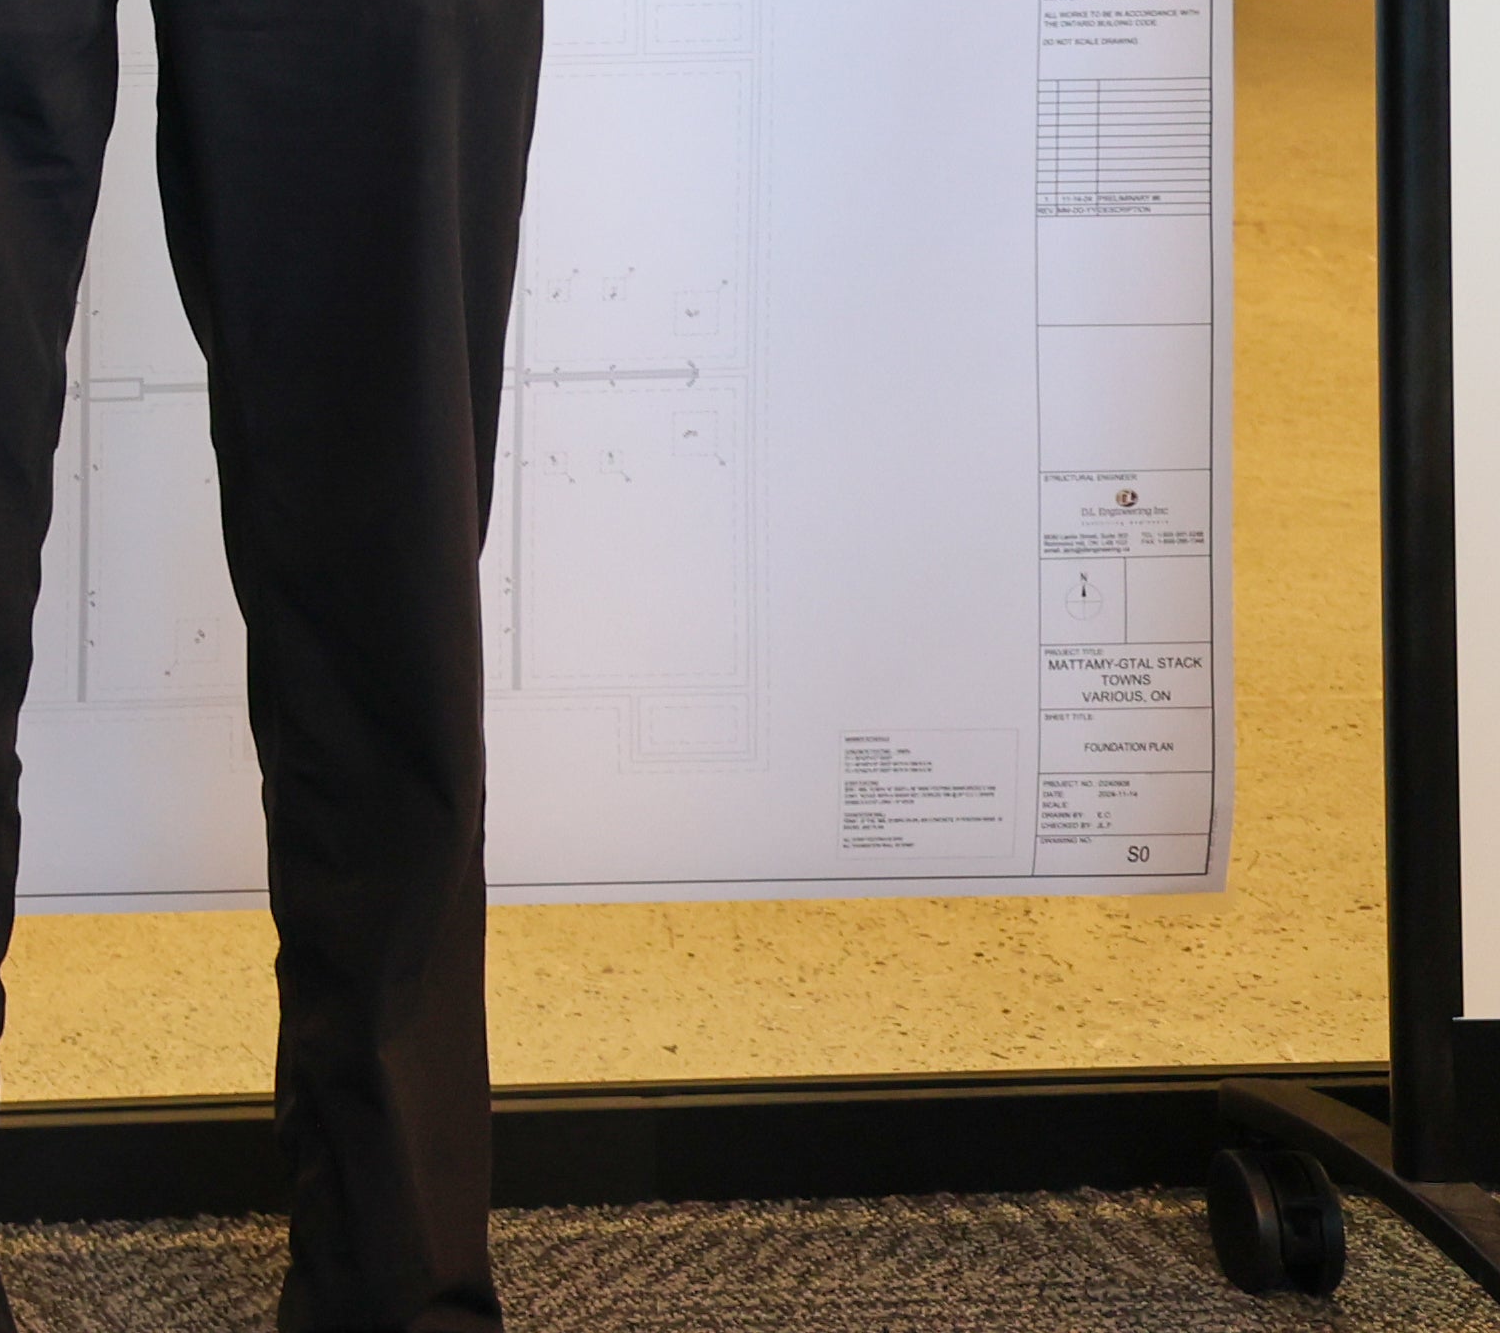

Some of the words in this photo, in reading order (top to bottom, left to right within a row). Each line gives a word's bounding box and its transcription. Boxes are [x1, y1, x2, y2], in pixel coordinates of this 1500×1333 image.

[1048, 659, 1153, 671] MATTAMY-GTAL
[1157, 657, 1203, 669] STACK
[1101, 674, 1152, 686] TOWNS
[1082, 691, 1147, 703] VARIOUS,
[1151, 691, 1171, 702] ON
[1084, 742, 1147, 752] FOUNDATION
[1149, 742, 1174, 752] PLAN
